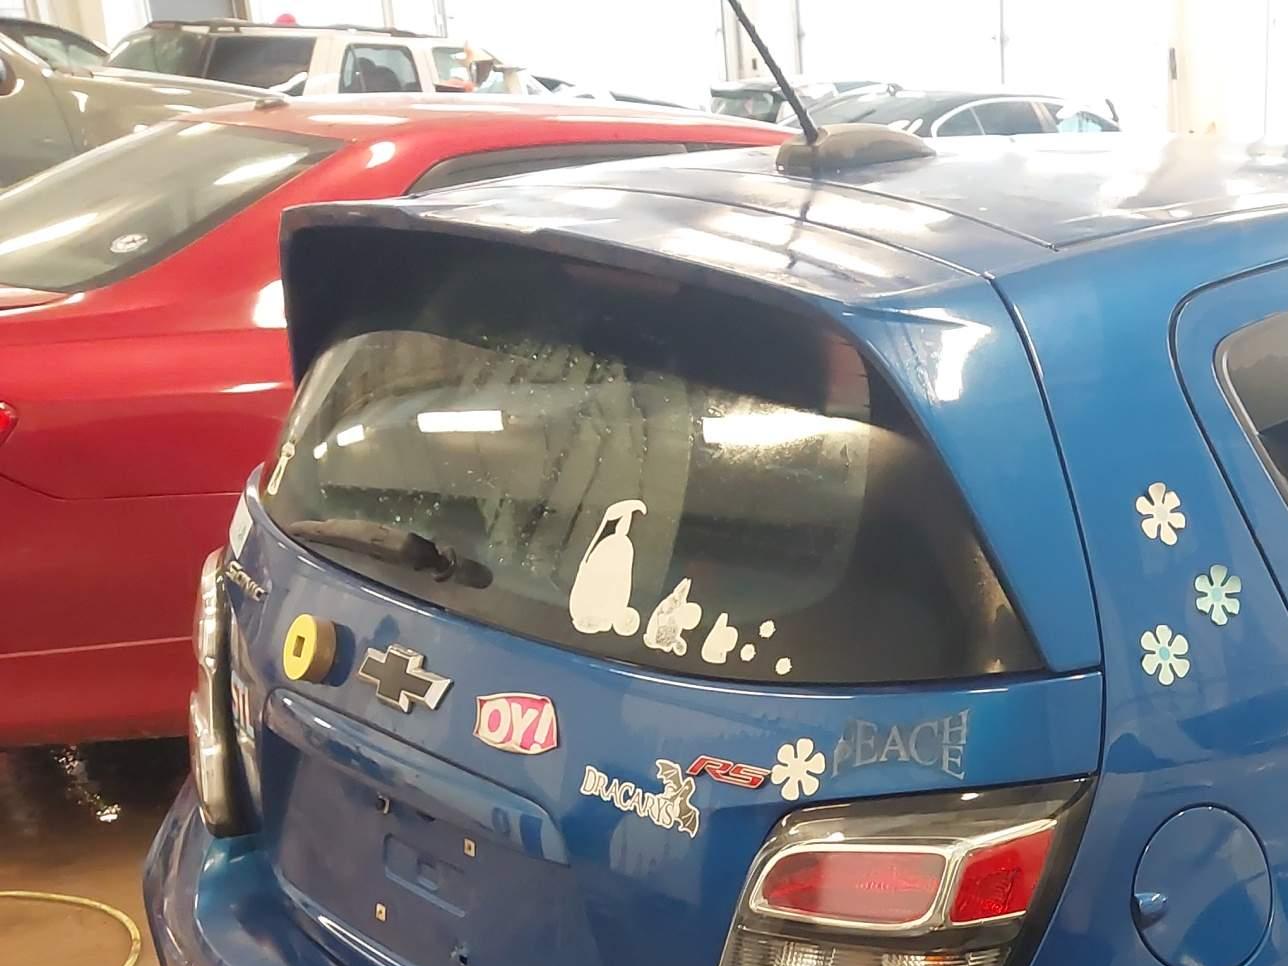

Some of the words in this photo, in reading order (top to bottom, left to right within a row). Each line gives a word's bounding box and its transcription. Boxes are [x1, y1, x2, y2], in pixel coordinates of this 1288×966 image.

[478, 698, 554, 751] OY!
[580, 766, 675, 829] DRACARYS
[687, 755, 771, 789] RS
